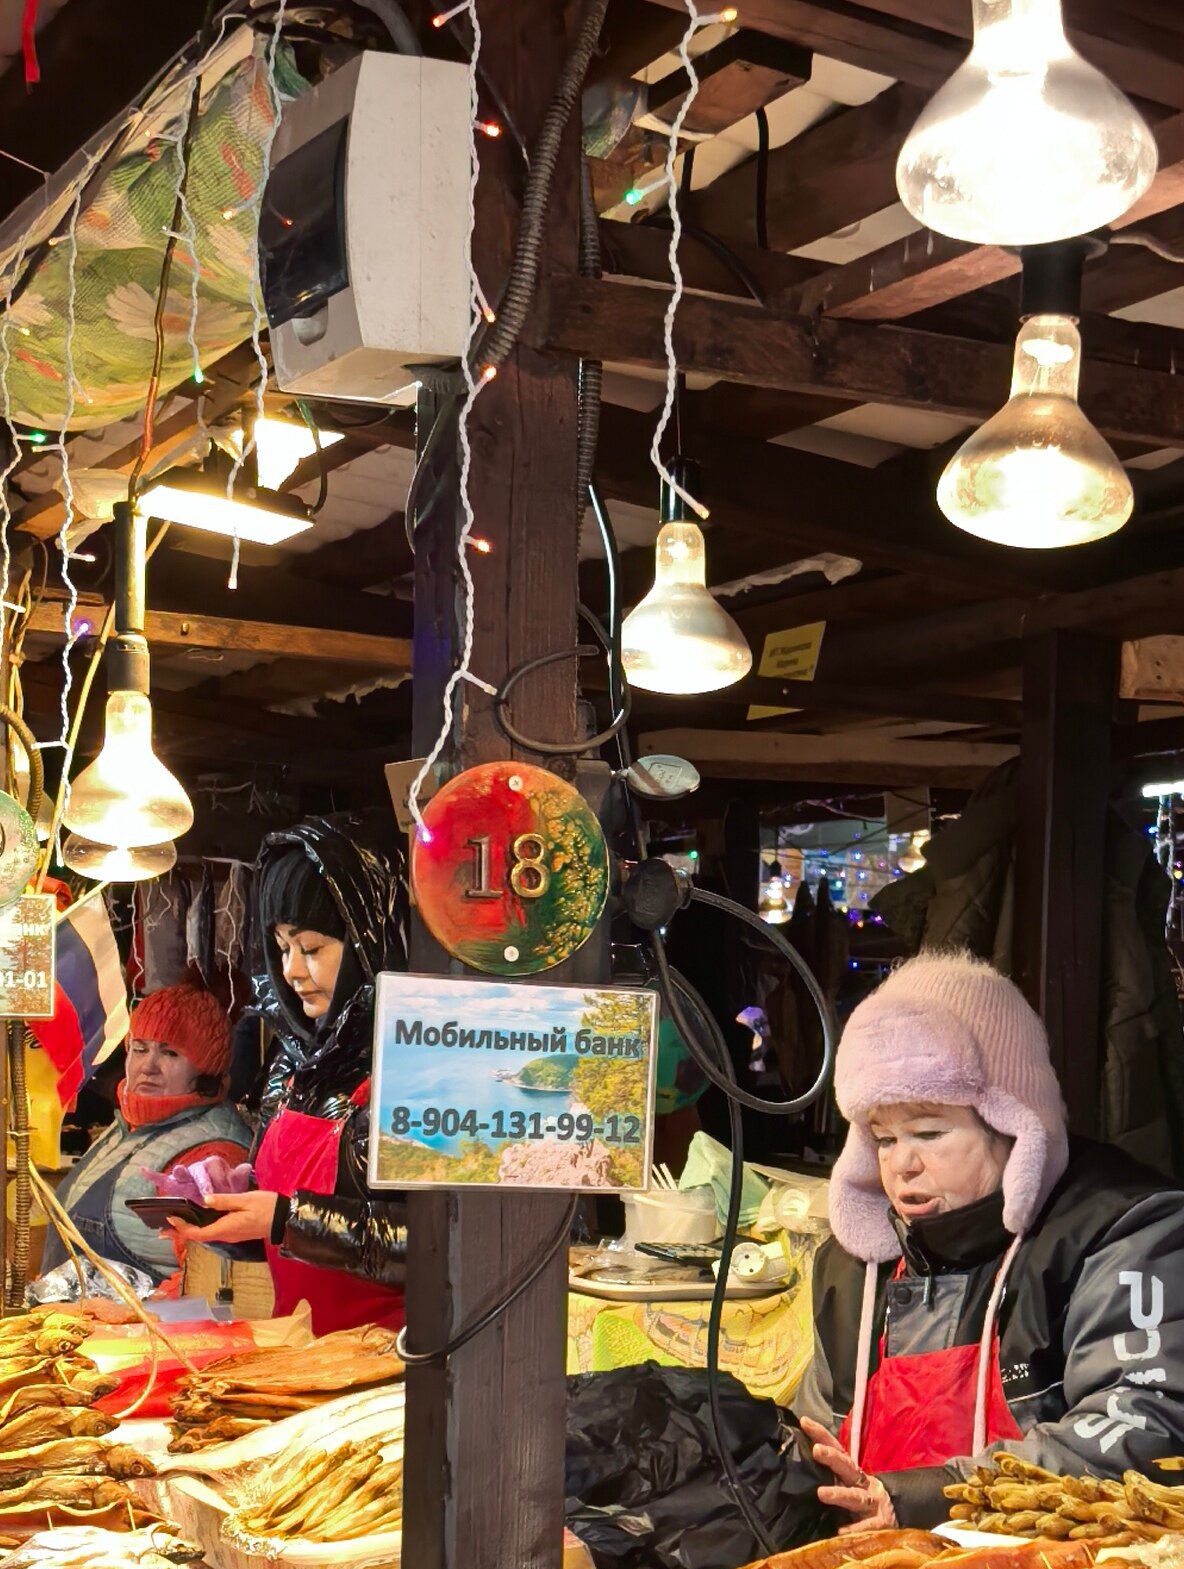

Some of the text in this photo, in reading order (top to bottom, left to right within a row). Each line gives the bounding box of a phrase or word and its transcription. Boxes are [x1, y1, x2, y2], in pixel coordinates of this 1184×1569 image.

[464, 832, 549, 899] 18
[396, 1018, 640, 1057] Мобильный банк
[391, 1106, 640, 1143] 8-904-131-99-12
